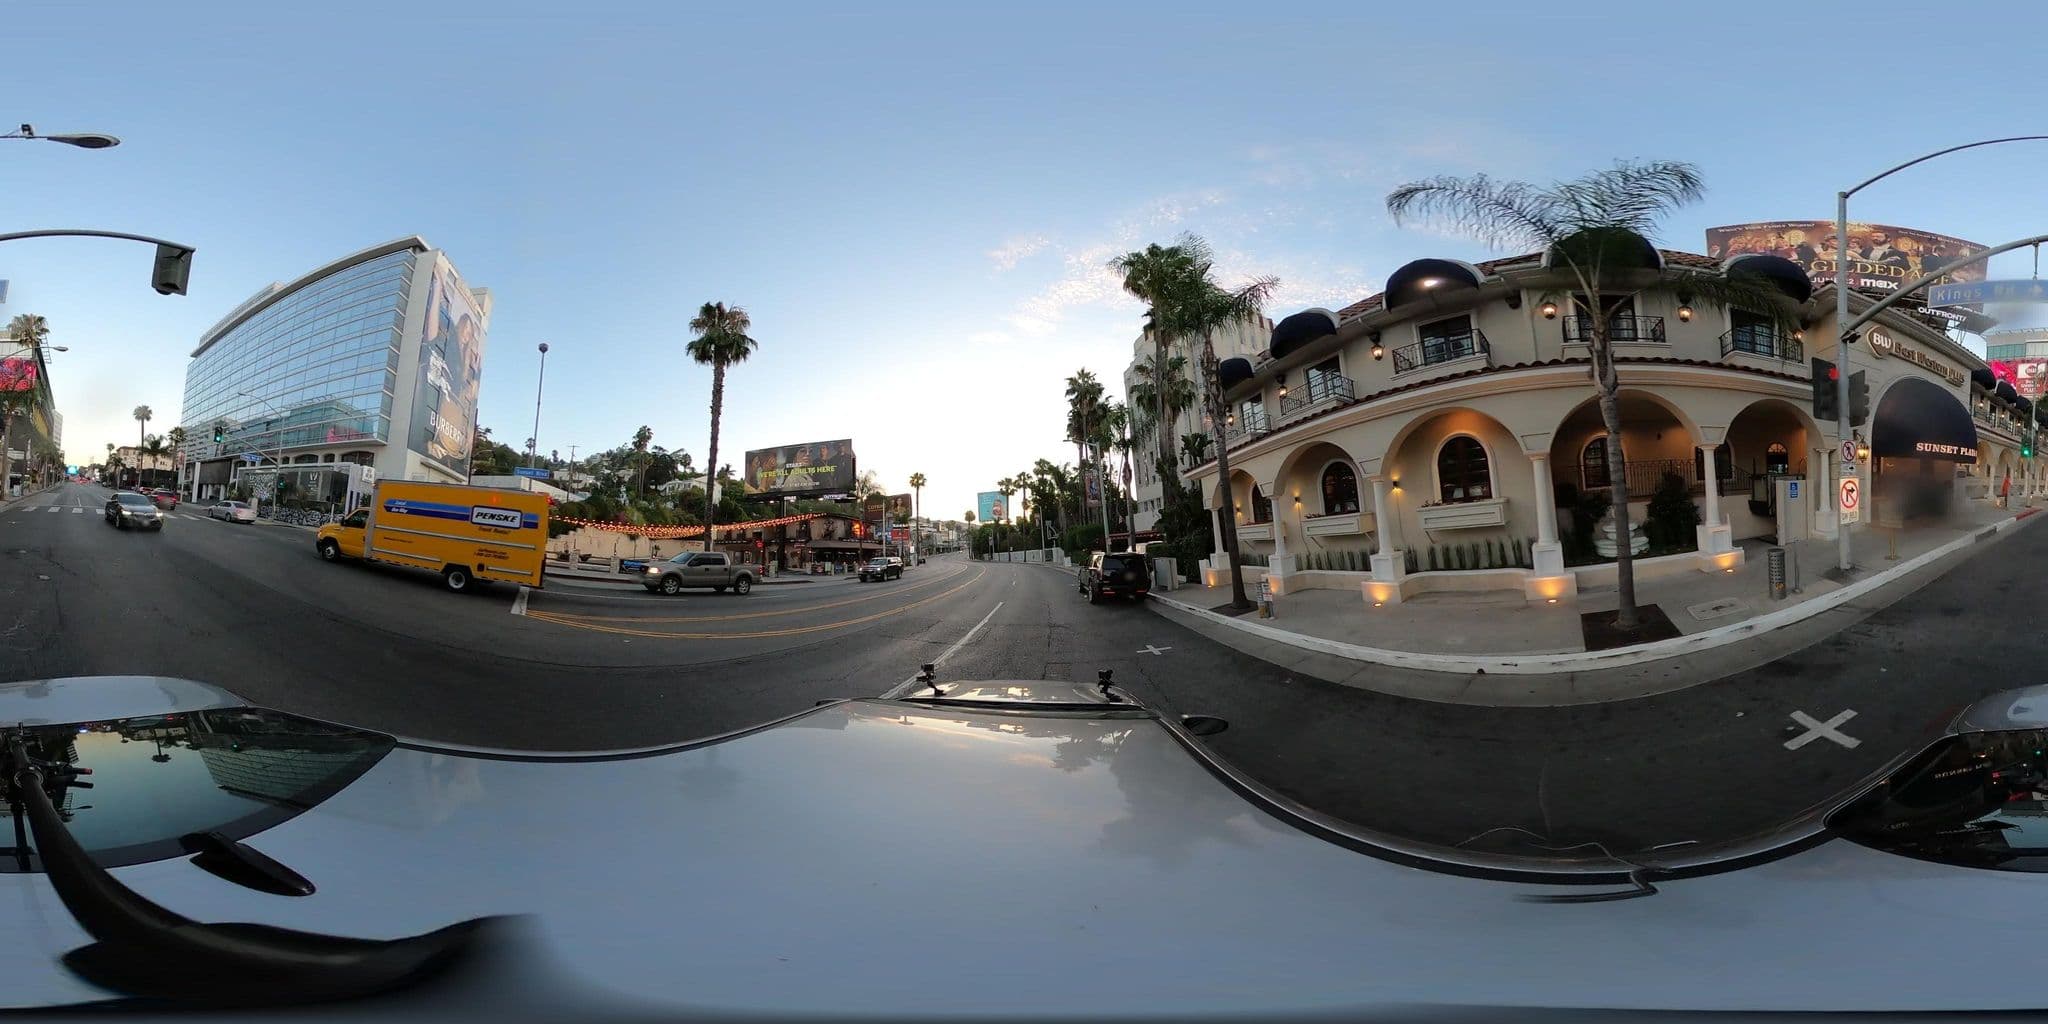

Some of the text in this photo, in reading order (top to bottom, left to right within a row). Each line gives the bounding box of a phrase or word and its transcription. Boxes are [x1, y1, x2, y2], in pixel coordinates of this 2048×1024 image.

[1860, 277, 1899, 290] max
[1872, 332, 1892, 349] BW
[1916, 442, 1959, 455] SUNSET
[475, 511, 519, 523] PENSKE
